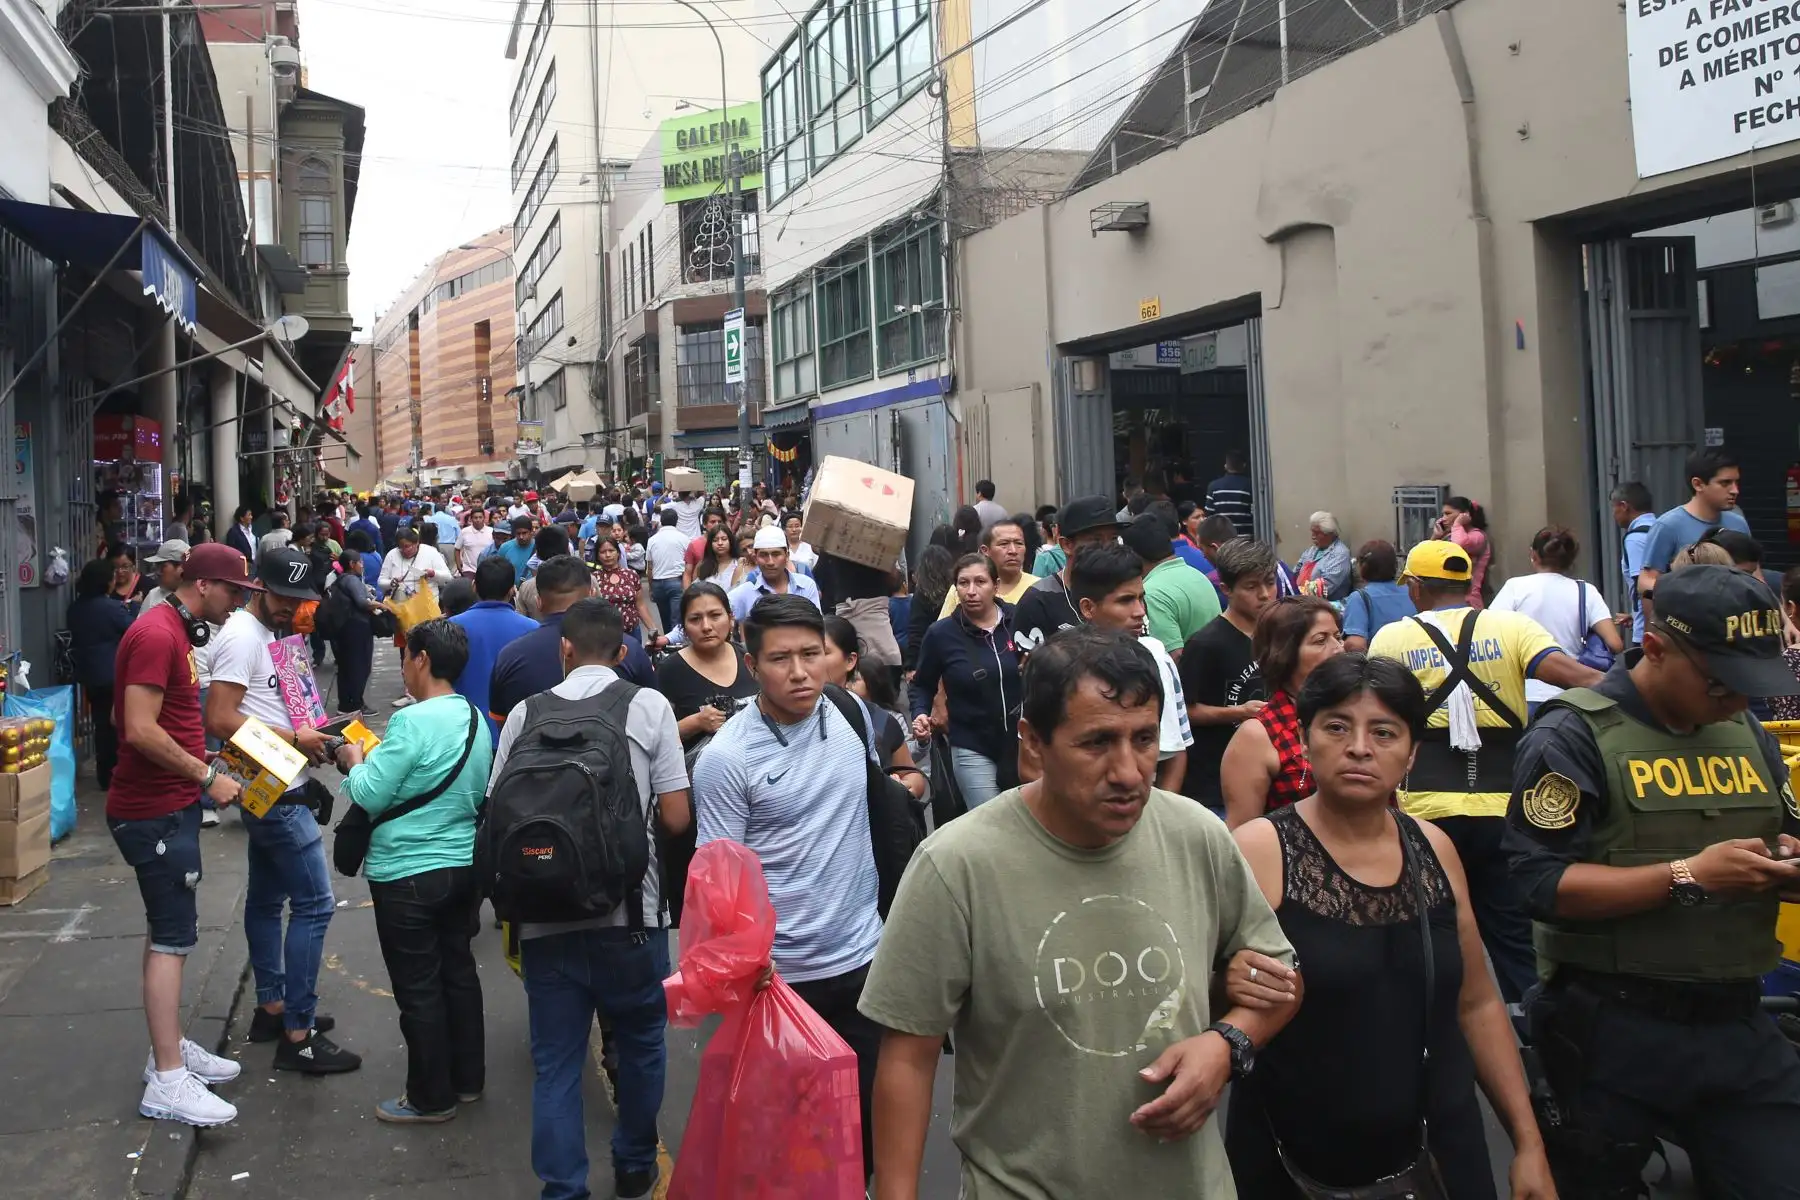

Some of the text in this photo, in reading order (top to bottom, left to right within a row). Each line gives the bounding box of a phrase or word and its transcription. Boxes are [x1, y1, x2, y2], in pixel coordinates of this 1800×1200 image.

[1686, 8, 1702, 29] A
[1658, 40, 1689, 67] DE
[1679, 69, 1696, 90] A
[663, 160, 699, 189] MESA
[1141, 304, 1157, 319] 662
[1160, 347, 1181, 357] 356
[1665, 614, 1692, 634] PERU
[1628, 755, 1769, 798] POLICIA
[1053, 945, 1171, 995] DOO
[1060, 984, 1173, 1005] AUSTRALIA
